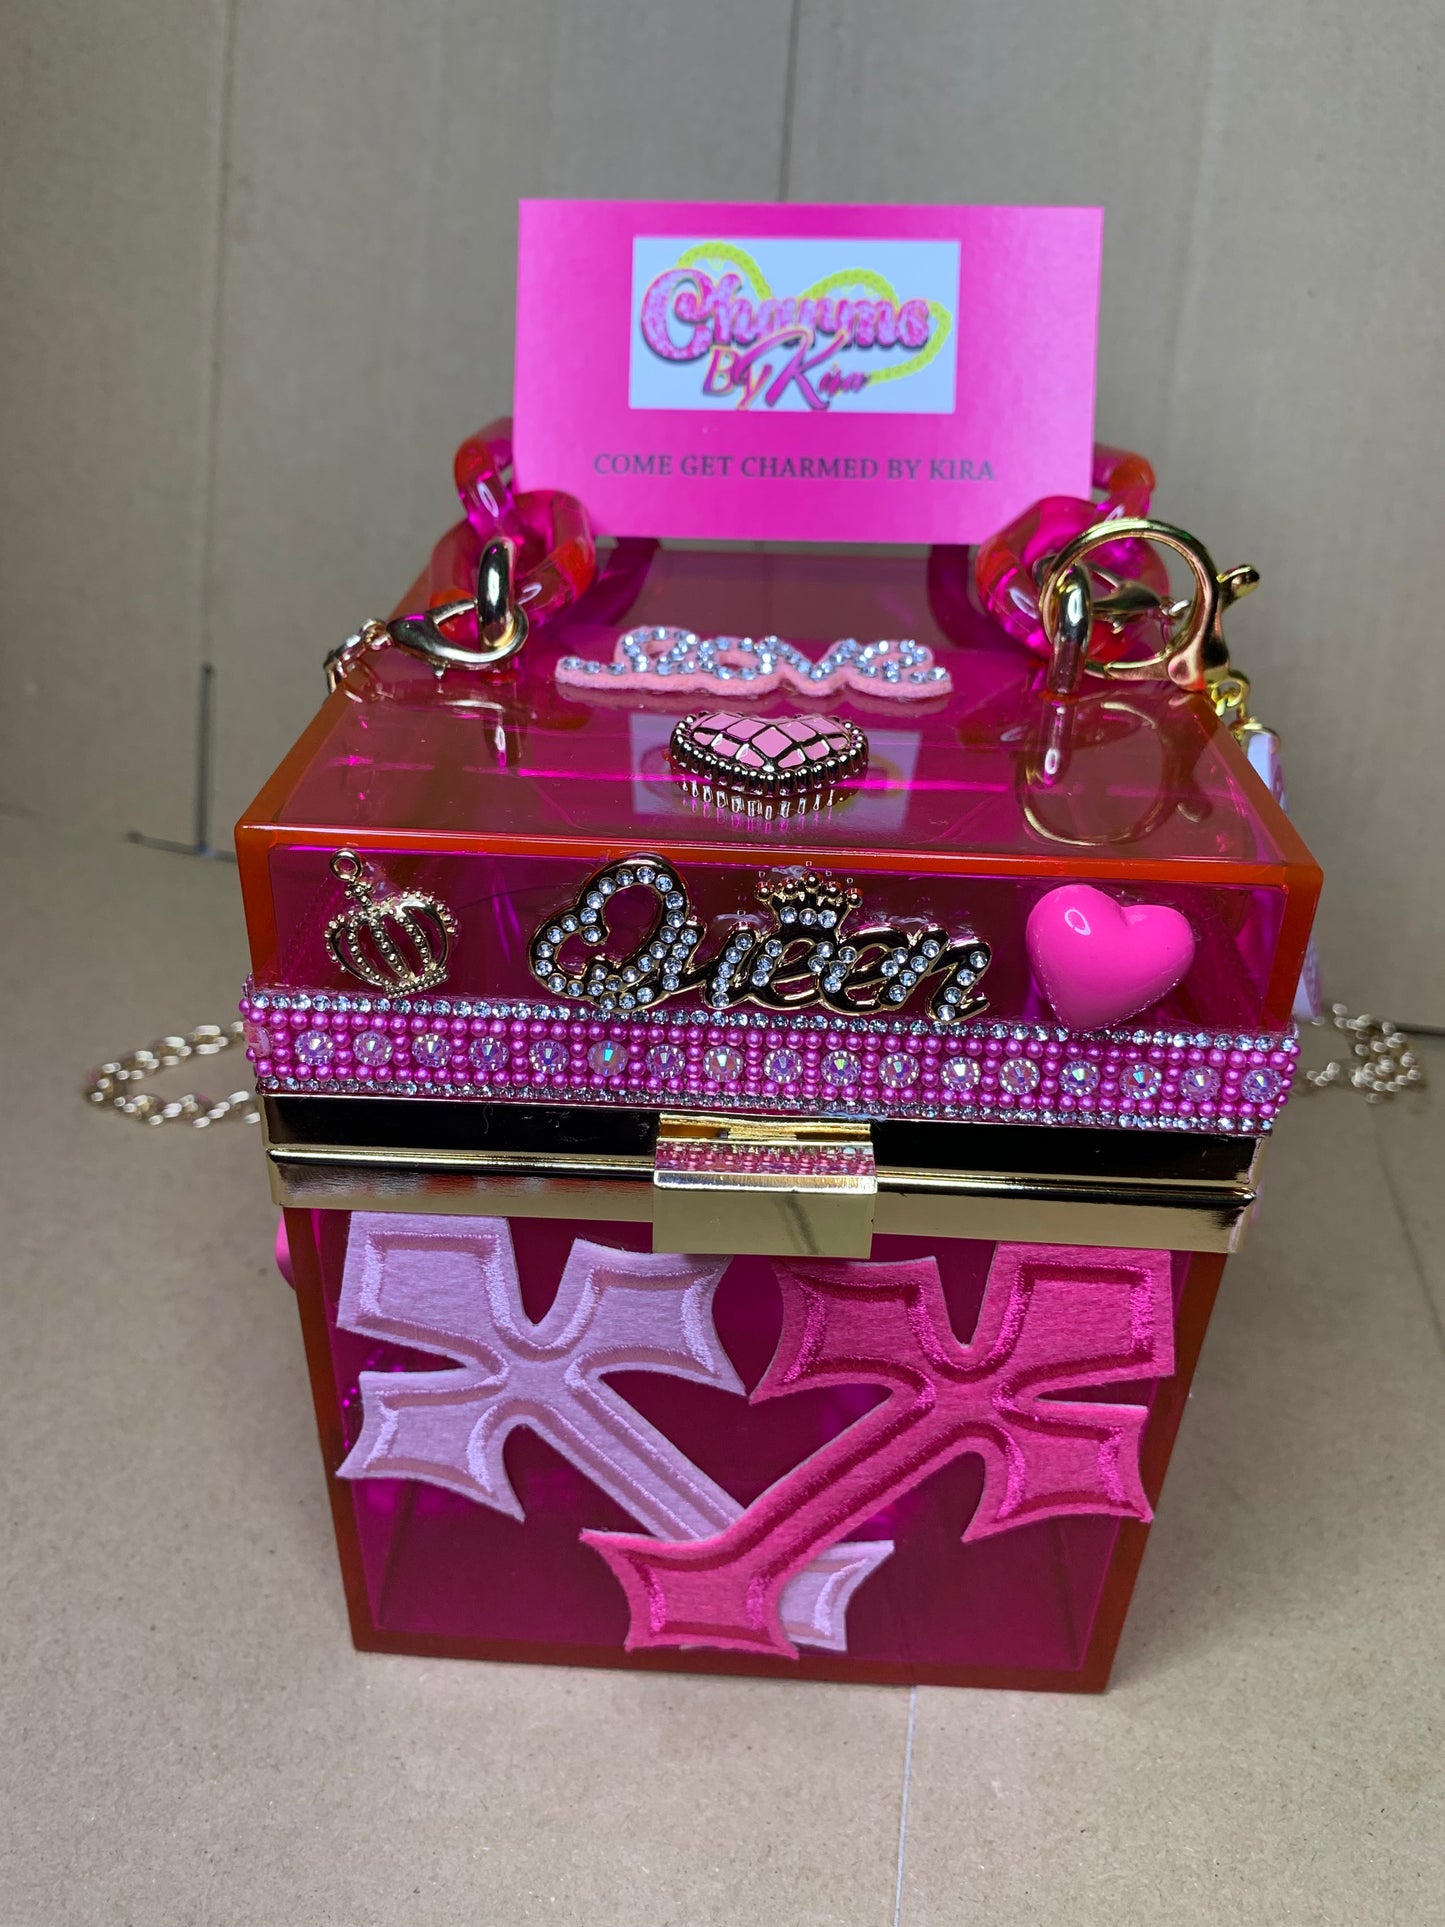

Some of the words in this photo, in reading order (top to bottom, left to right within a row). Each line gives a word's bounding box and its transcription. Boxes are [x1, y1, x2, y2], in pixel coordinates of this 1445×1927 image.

[641, 267, 931, 363] Charms
[702, 344, 773, 410] By
[737, 327, 869, 411] Kira
[593, 453, 673, 476] COME
[680, 454, 734, 477] GET
[740, 456, 879, 479] CHARMED
[887, 458, 922, 480] BY
[929, 459, 996, 481] KIRA
[528, 853, 993, 1023] Queen
